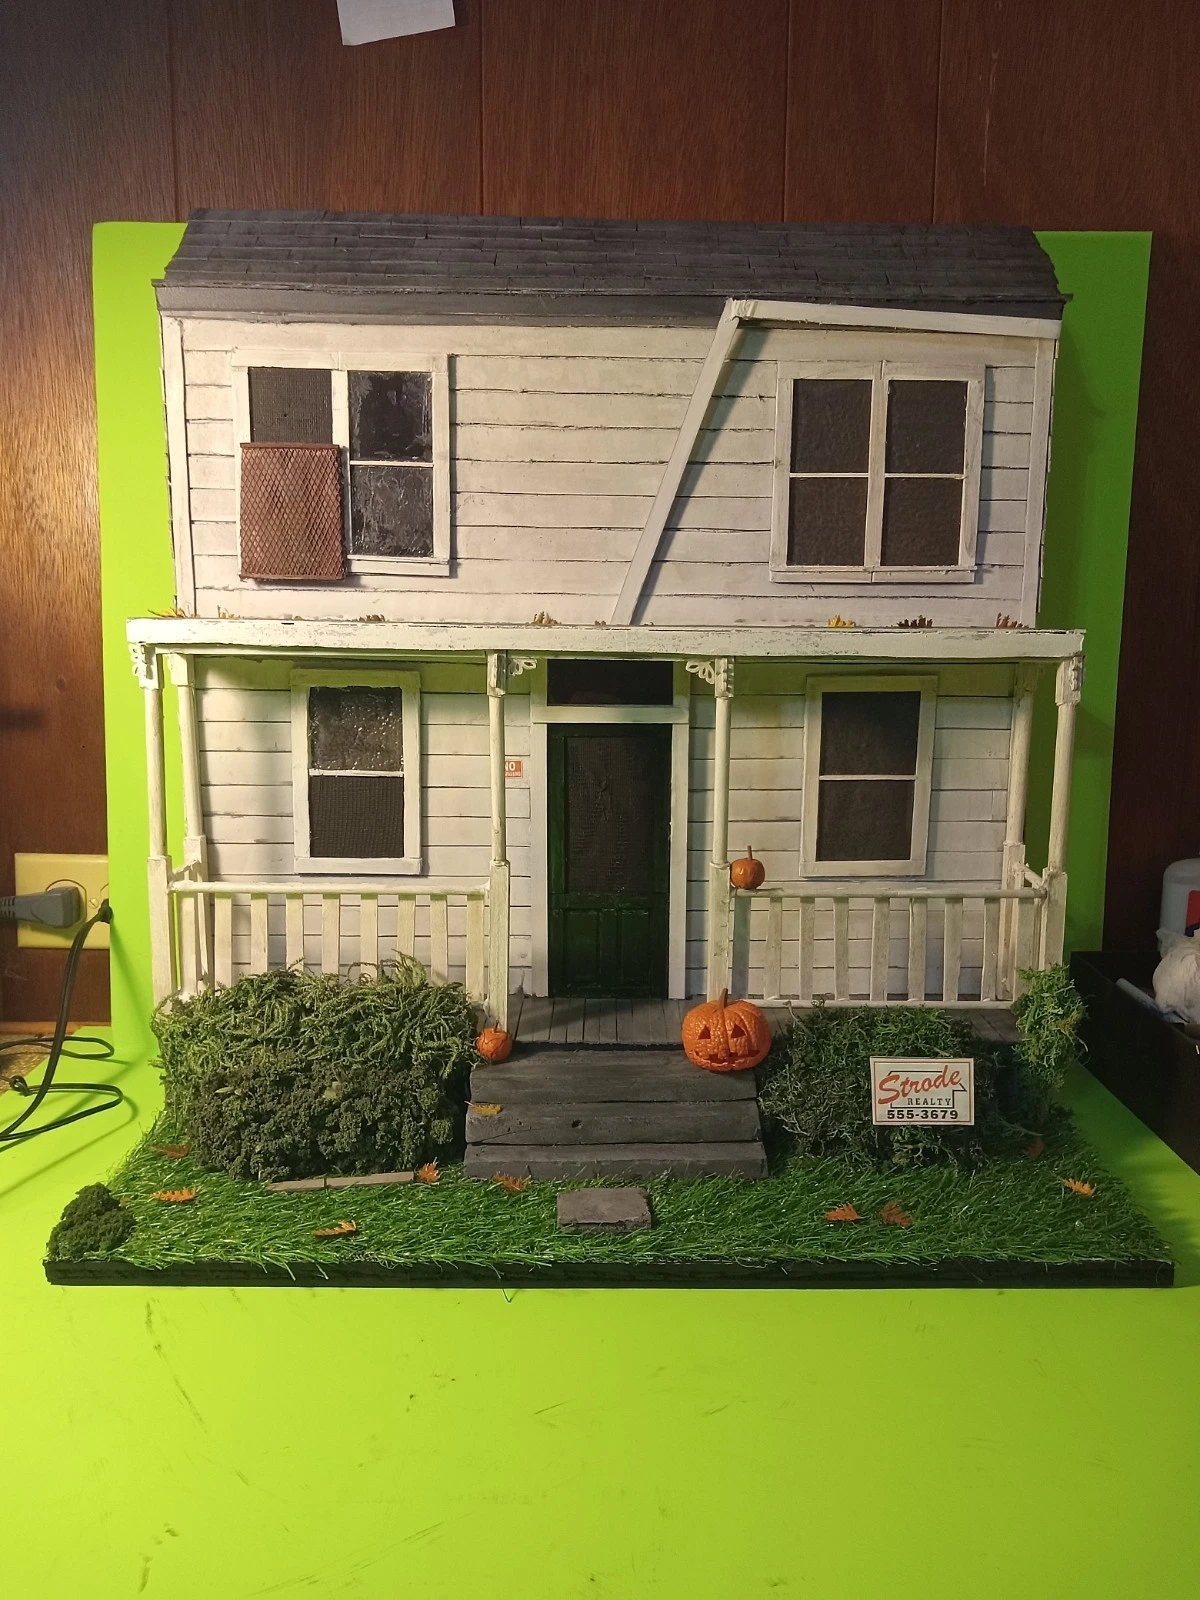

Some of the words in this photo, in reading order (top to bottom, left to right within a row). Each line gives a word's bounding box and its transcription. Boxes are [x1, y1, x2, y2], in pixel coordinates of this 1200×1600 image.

[878, 1065, 961, 1104] Strode
[907, 1098, 951, 1106] REALTY
[887, 1110, 958, 1119] 555-3679
